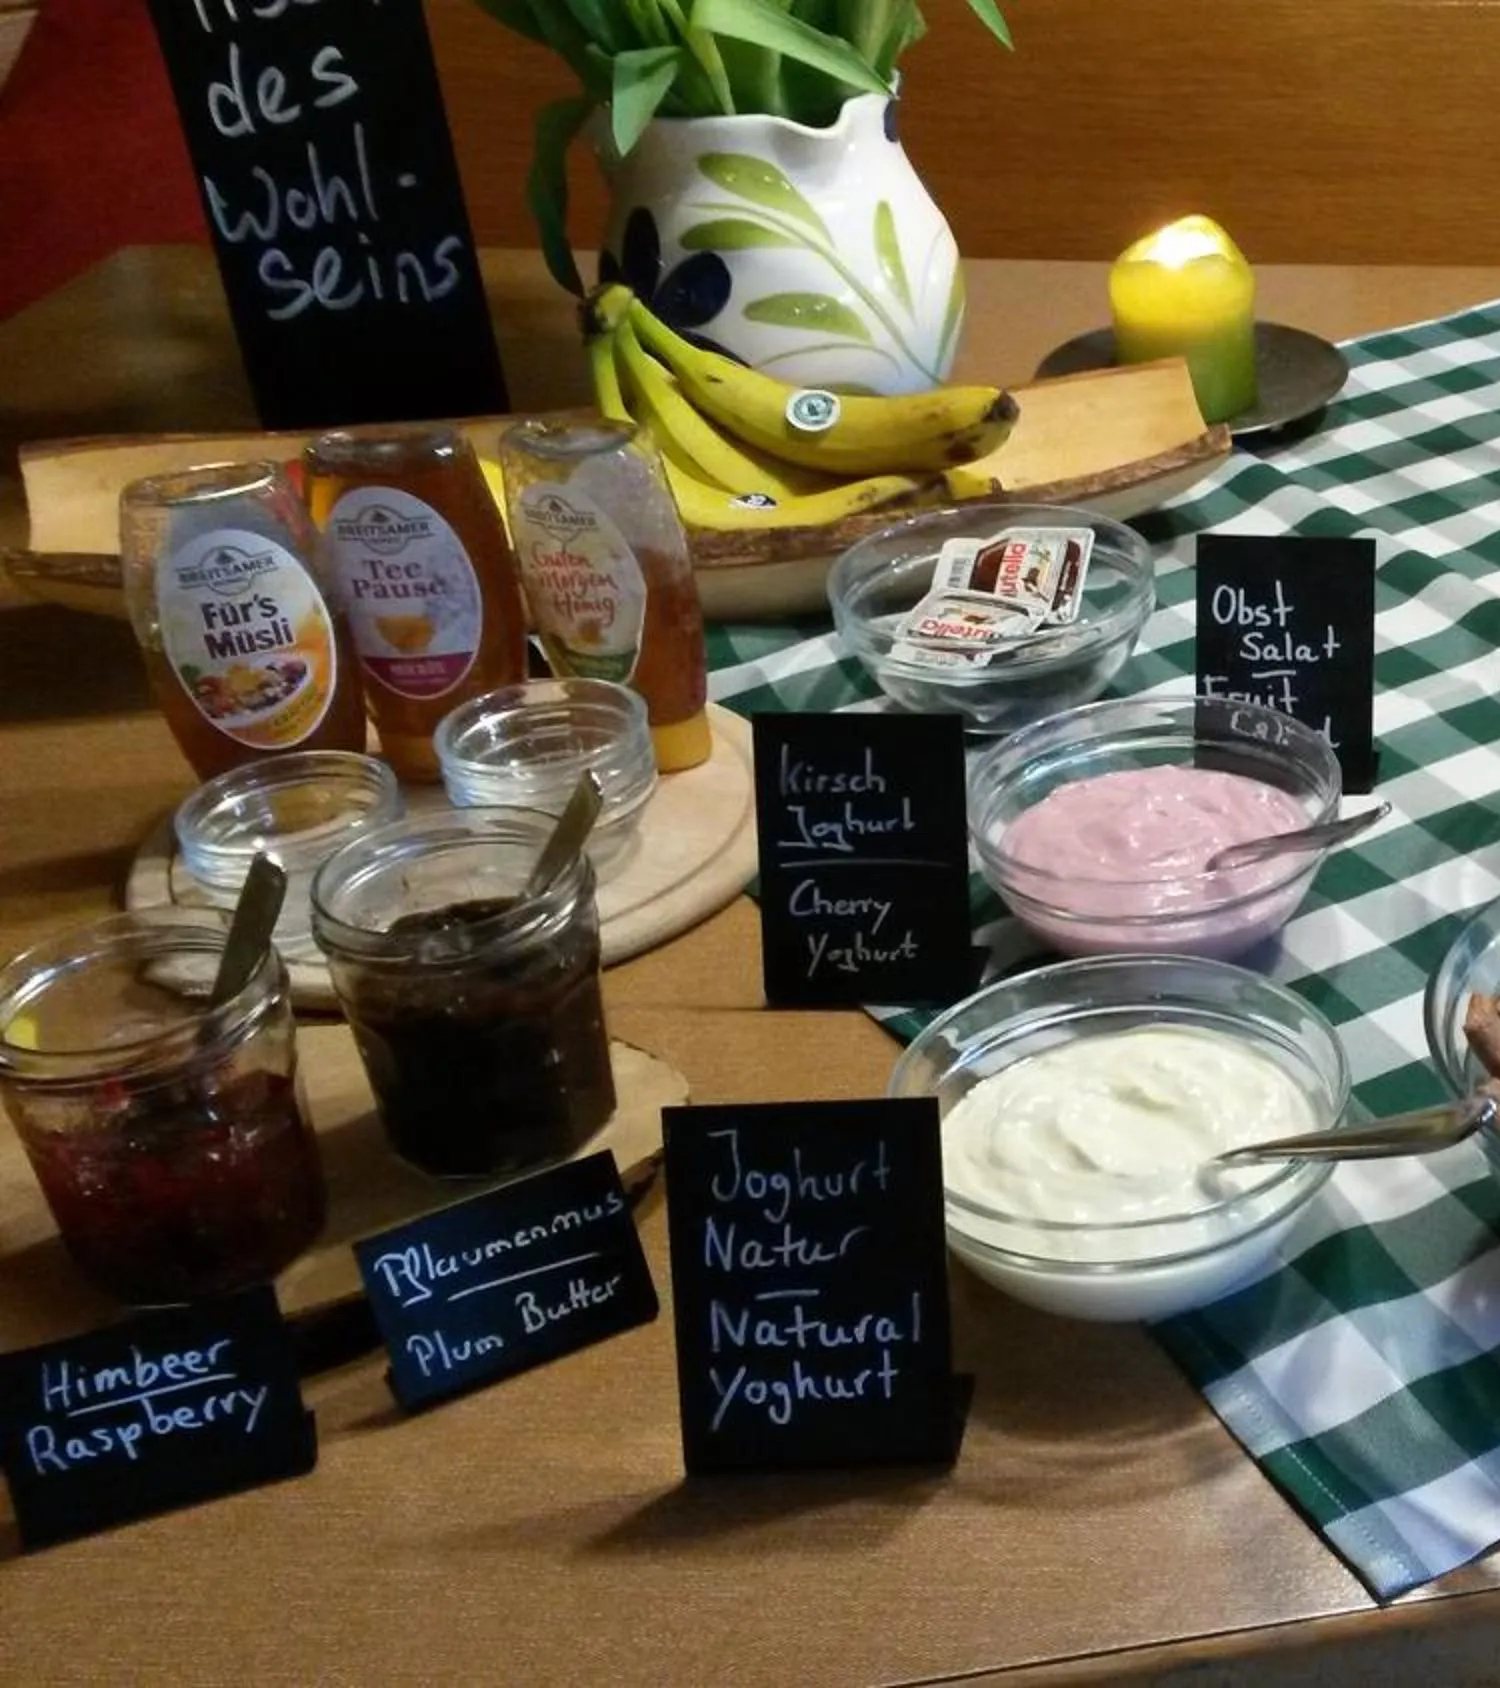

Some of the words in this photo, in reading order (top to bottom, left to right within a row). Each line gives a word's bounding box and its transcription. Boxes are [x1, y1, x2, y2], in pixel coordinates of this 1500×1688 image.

[206, 42, 360, 137] des
[351, 573, 449, 601] Pause
[361, 559, 422, 581] Tee
[201, 592, 279, 630] Für's
[920, 618, 994, 641] utella
[1211, 579, 1295, 627] Obst
[203, 617, 295, 660] Müsli
[1239, 624, 1342, 663] Salat
[779, 743, 886, 795] Kirsch
[788, 879, 892, 936] Cherry
[807, 930, 919, 978] Yoghurt
[707, 1129, 891, 1223] Joghurt
[373, 1191, 625, 1308] Pflaumenmus
[704, 1216, 870, 1272] Natur
[406, 1330, 505, 1377] Plum
[514, 1273, 623, 1334] Butter
[710, 1291, 921, 1353] Natural
[40, 1338, 232, 1412] Himbeer
[709, 1348, 898, 1432] Yoghurt
[26, 1385, 268, 1476] Raspberry
